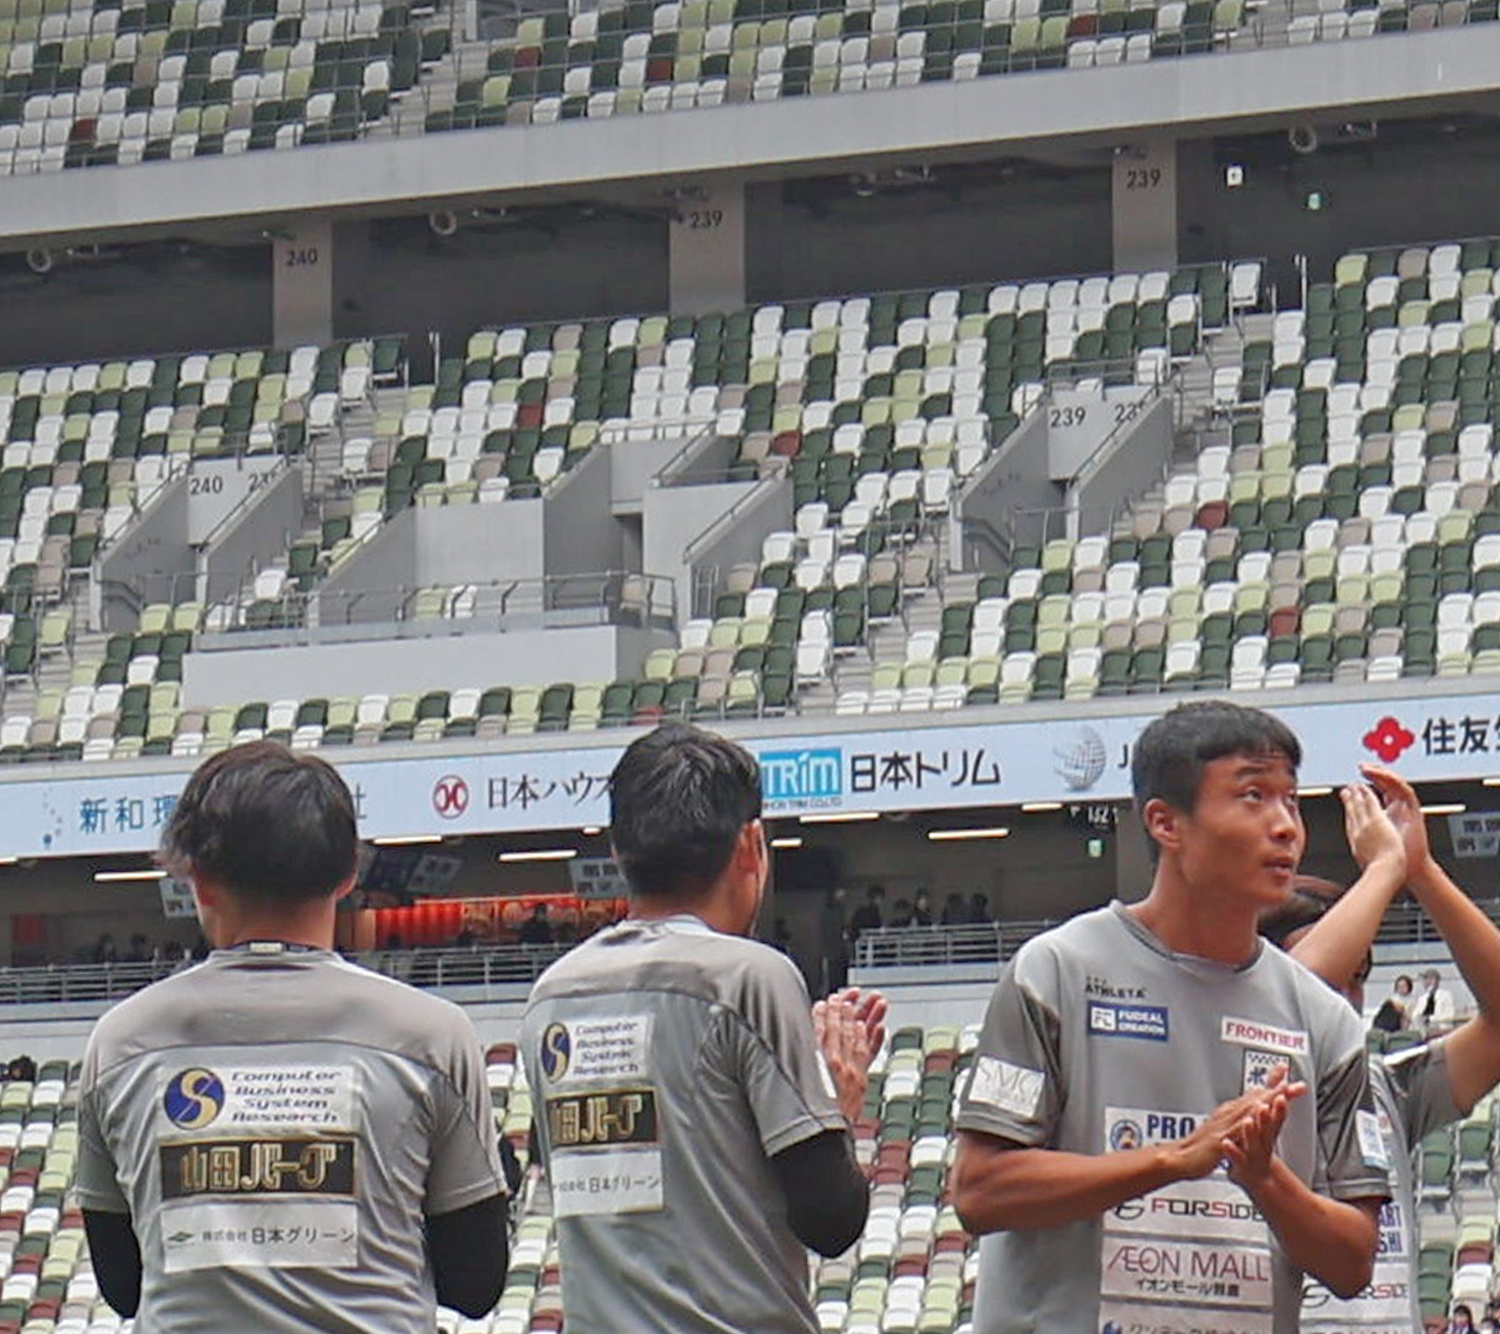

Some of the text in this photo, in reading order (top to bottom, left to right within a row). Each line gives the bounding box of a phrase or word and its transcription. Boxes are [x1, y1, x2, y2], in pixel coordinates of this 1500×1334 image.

[1126, 168, 1161, 189] 239
[690, 210, 724, 229] 239
[1050, 407, 1086, 428] 239
[190, 477, 223, 495] 240
[850, 749, 1000, 794] 日本トリム
[1225, 1021, 1306, 1051] FRONTIER
[232, 1070, 342, 1083] Computer
[234, 1083, 336, 1095] Business
[242, 1098, 329, 1110] System
[231, 1112, 338, 1123] Research
[1147, 1113, 1196, 1140] PRO
[251, 1227, 355, 1245] 日本グリーン
[1191, 1251, 1269, 1282] MALL
